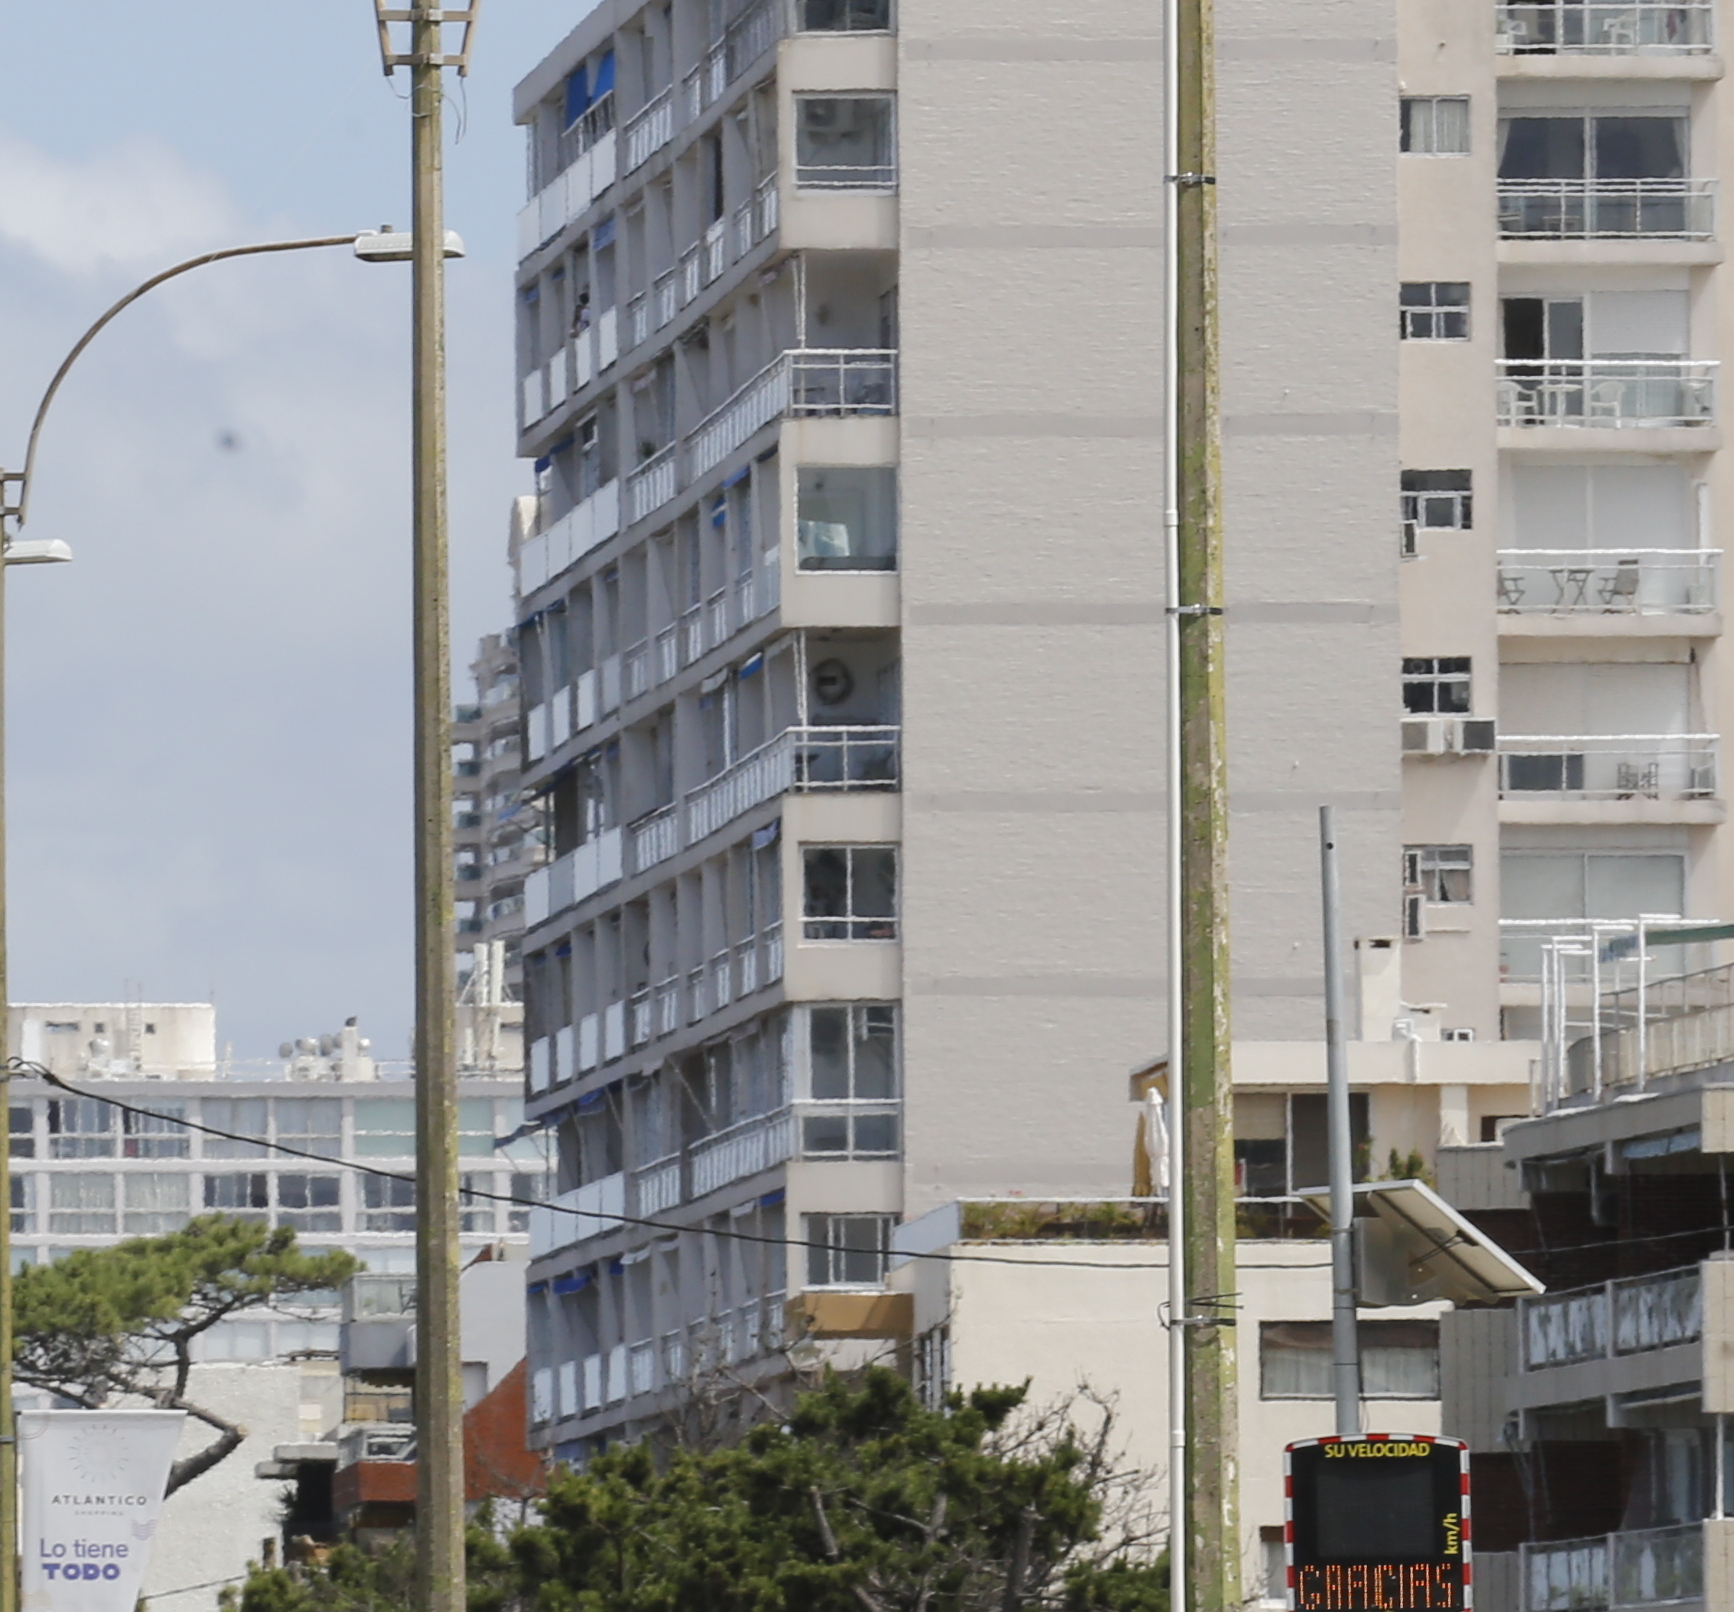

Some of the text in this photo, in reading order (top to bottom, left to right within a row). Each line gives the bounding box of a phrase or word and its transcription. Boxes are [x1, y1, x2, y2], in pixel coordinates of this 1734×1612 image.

[1325, 1442, 1430, 1458] SU VELOCIDAD
[1443, 1513, 1460, 1554] km/h
[40, 1538, 129, 1558] Lo tiene
[41, 1563, 121, 1581] TODO
